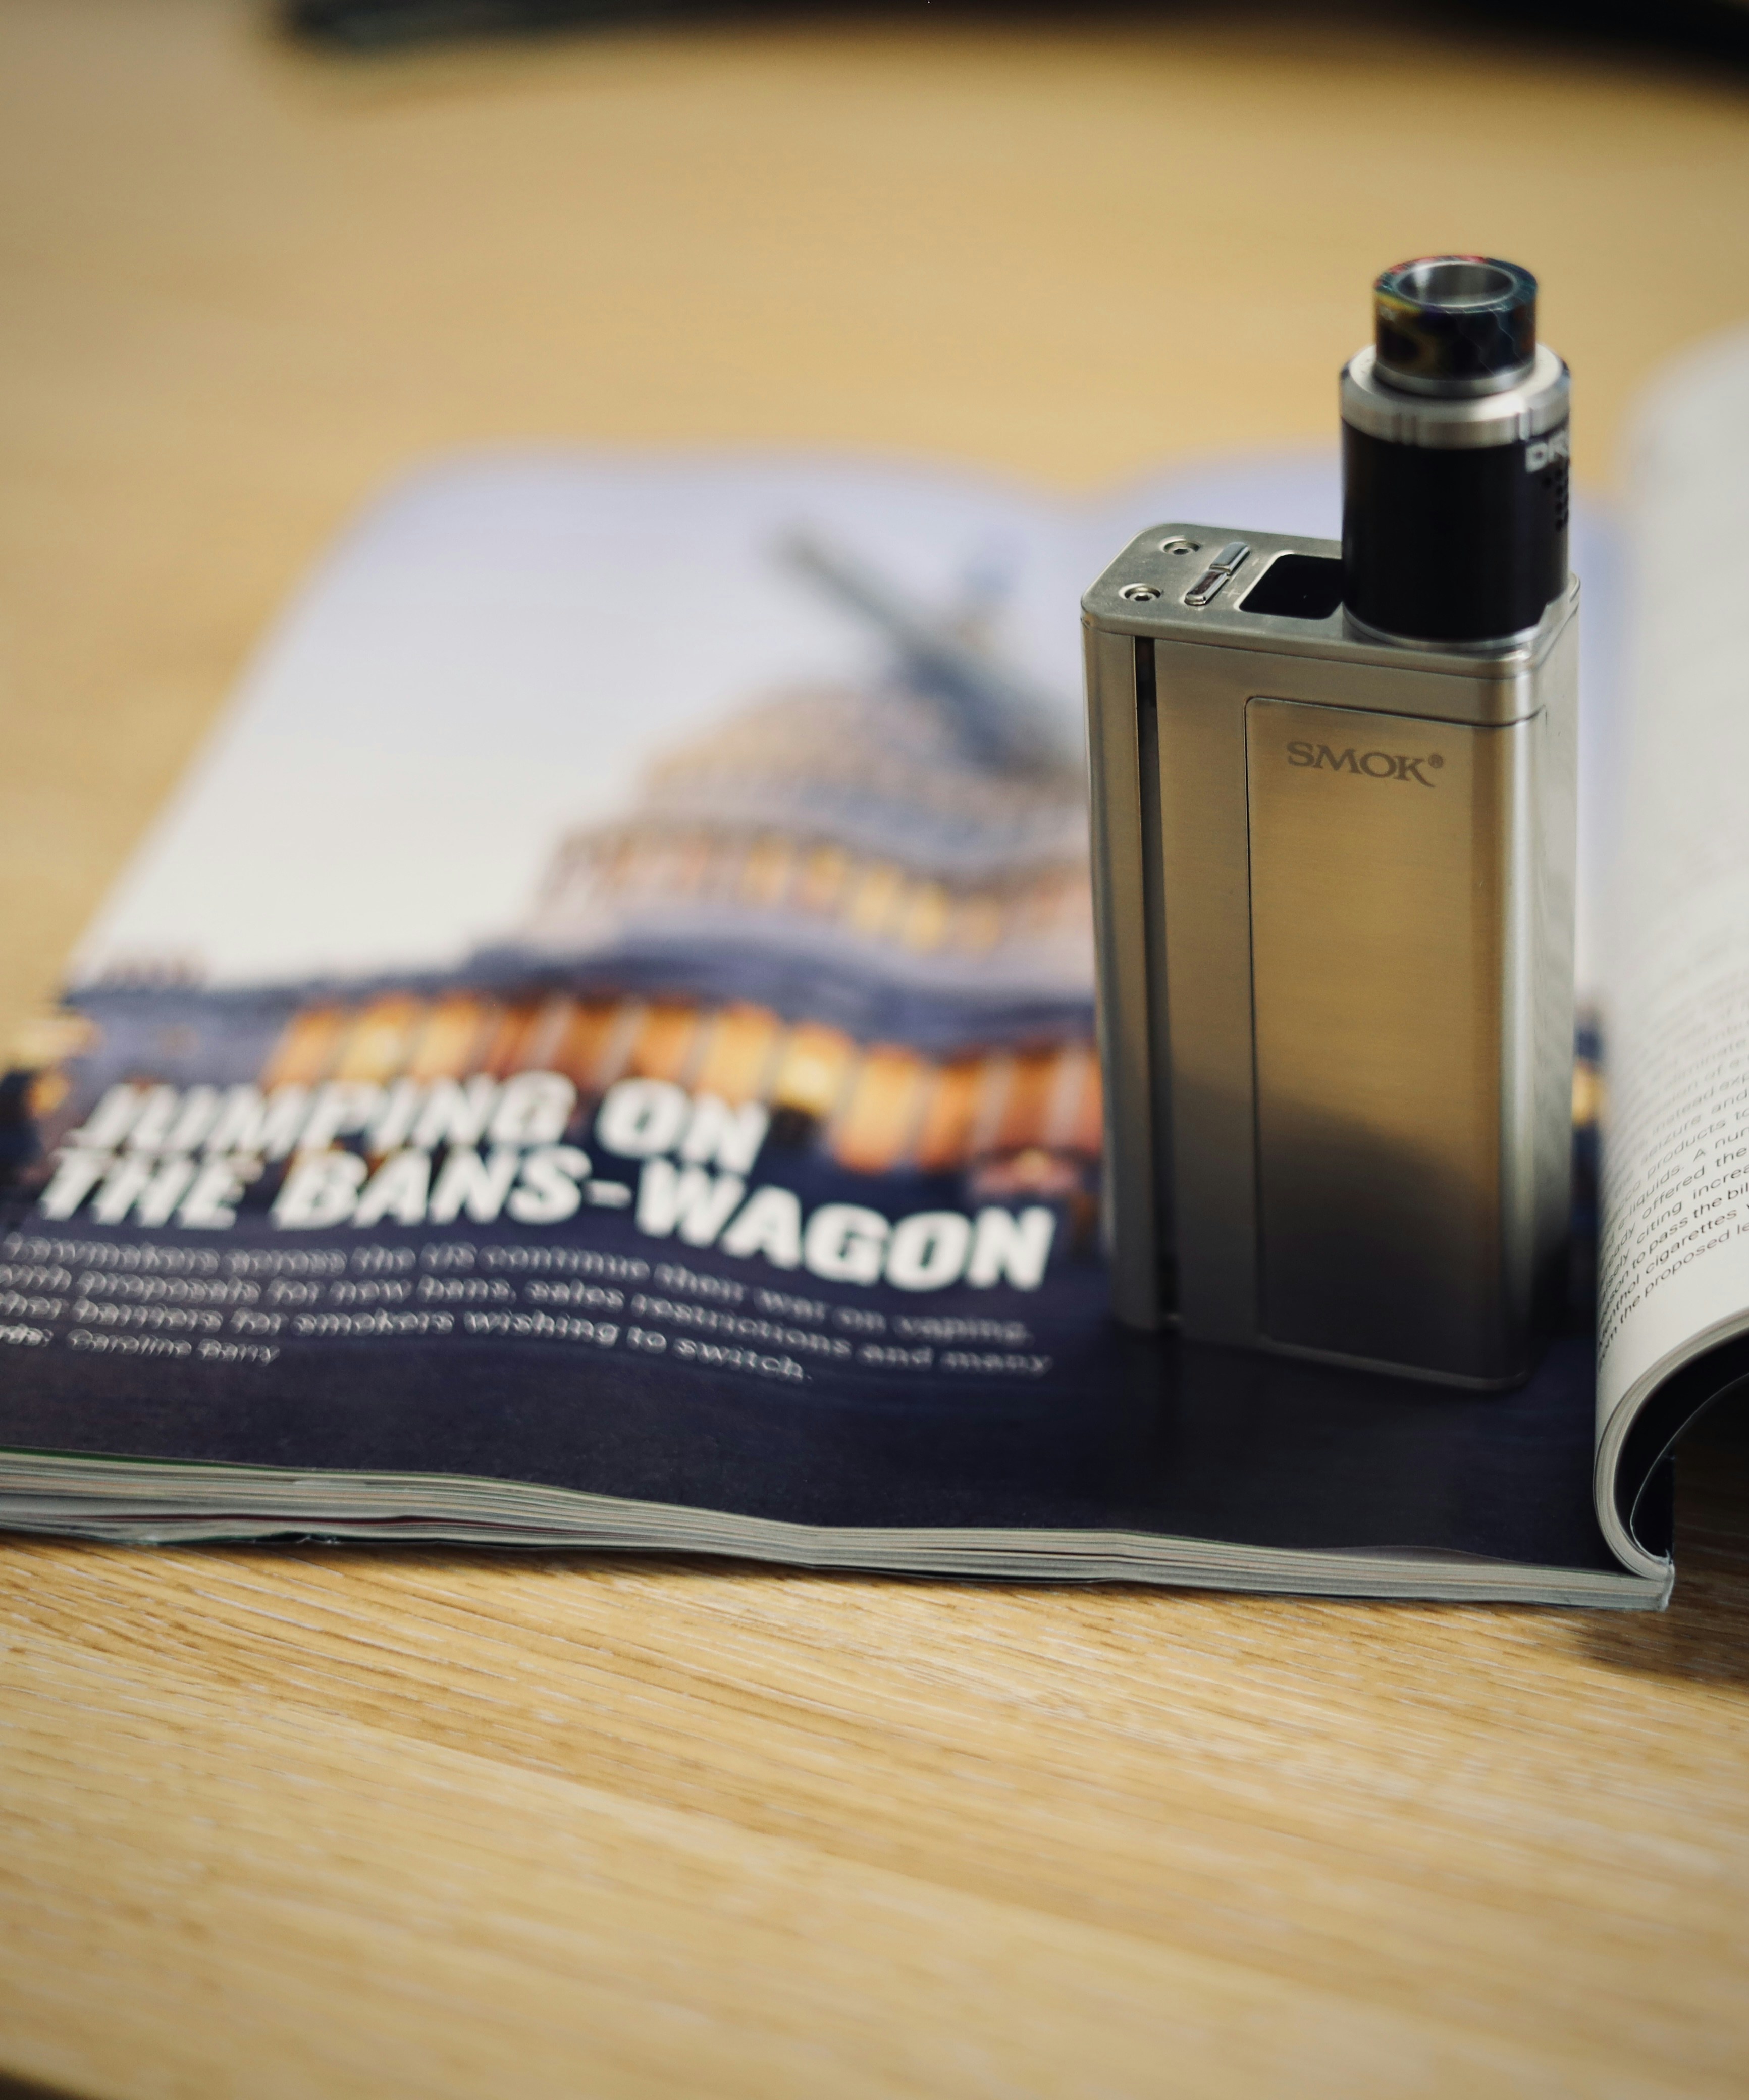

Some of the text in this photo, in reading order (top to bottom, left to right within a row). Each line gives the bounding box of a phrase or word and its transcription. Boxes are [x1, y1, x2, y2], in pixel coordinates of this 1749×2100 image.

[66, 1070, 769, 1177] JUMPING ON
[1641, 1114, 1702, 1166] seizure
[1711, 1088, 1747, 1114] and
[1653, 1086, 1714, 1135] instead
[1642, 1165, 1705, 1219] offered
[1716, 1147, 1747, 1167] the
[1647, 1119, 1726, 1180] products
[39, 1145, 1055, 1292] THE BANS-WAGON
[1618, 1165, 1684, 1231] e-liquids.
[1693, 1148, 1706, 1162] A
[1637, 1201, 1682, 1245] citing
[1632, 1252, 1646, 1269] to
[1649, 1217, 1688, 1254] pass
[1693, 1197, 1722, 1219] the
[1646, 1209, 1737, 1274] cigarettes
[1620, 1295, 1641, 1324] the
[1645, 1228, 1730, 1298] proposed
[230, 1306, 289, 1335] for
[291, 1307, 454, 1336] smokers
[463, 1307, 621, 1349] wishing
[626, 1326, 667, 1354] to
[524, 1278, 625, 1312] sales
[630, 1293, 853, 1362] restrictions
[857, 1343, 934, 1373] and
[940, 1350, 1053, 1380] many
